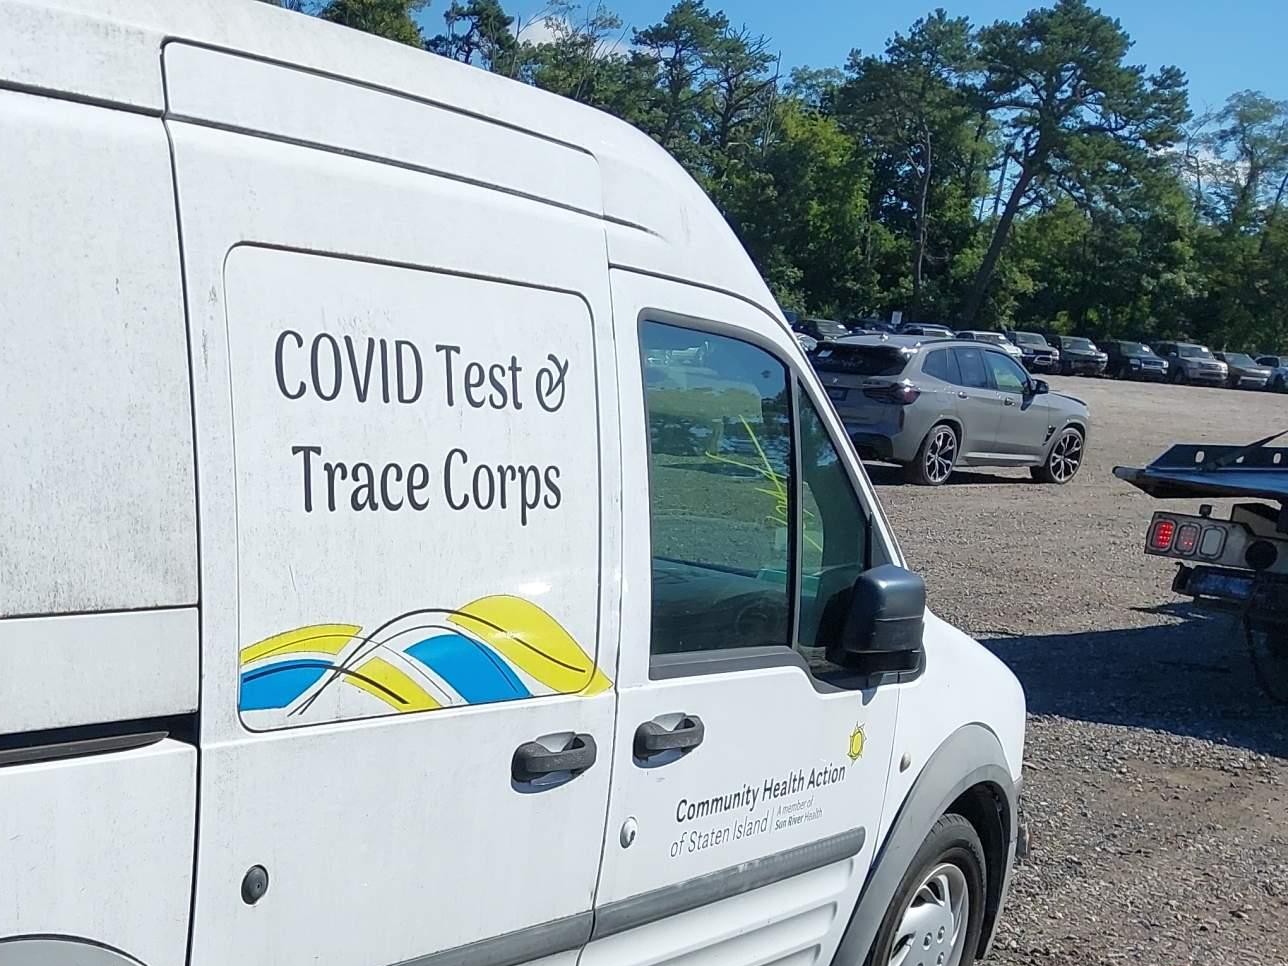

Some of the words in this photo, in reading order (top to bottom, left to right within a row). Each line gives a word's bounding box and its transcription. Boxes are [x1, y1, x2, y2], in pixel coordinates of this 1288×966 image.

[275, 330, 423, 404] COVID
[435, 344, 523, 411] Test
[535, 353, 569, 413] &
[291, 445, 430, 513] Trace
[444, 447, 562, 526] Corps
[676, 783, 760, 823] Community
[762, 769, 805, 802] Health
[807, 762, 846, 790] Action
[775, 819, 787, 831] Sun
[788, 814, 804, 827] River
[804, 807, 823, 823] Health
[777, 805, 782, 816] A
[782, 799, 807, 814] member
[807, 794, 814, 808] of
[670, 831, 688, 858] of
[687, 826, 730, 853] Staten
[732, 809, 770, 841] Island
